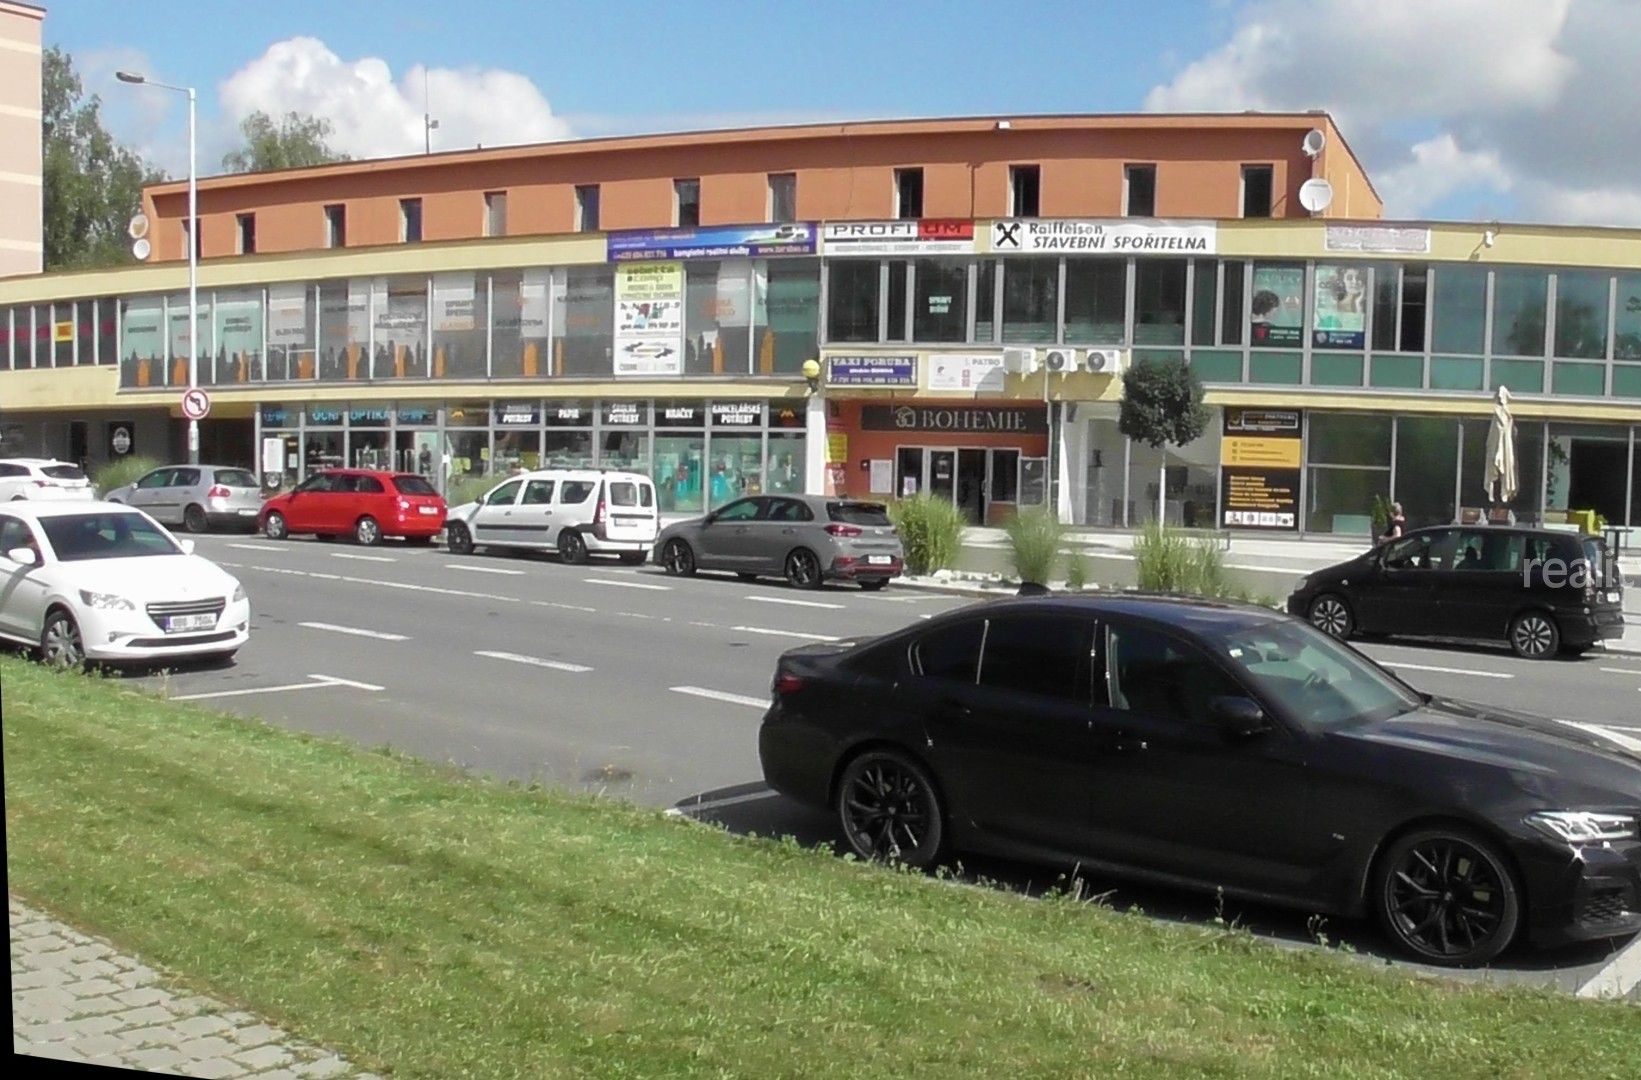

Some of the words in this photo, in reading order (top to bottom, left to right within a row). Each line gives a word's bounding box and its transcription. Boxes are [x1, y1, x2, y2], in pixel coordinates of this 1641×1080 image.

[833, 223, 912, 236] PROFI
[1033, 232, 1108, 250] STAVEBNÍ
[1112, 231, 1208, 251] SPOŘITELNA
[832, 357, 861, 367] TAXI
[922, 410, 1028, 431] BOHEMIE
